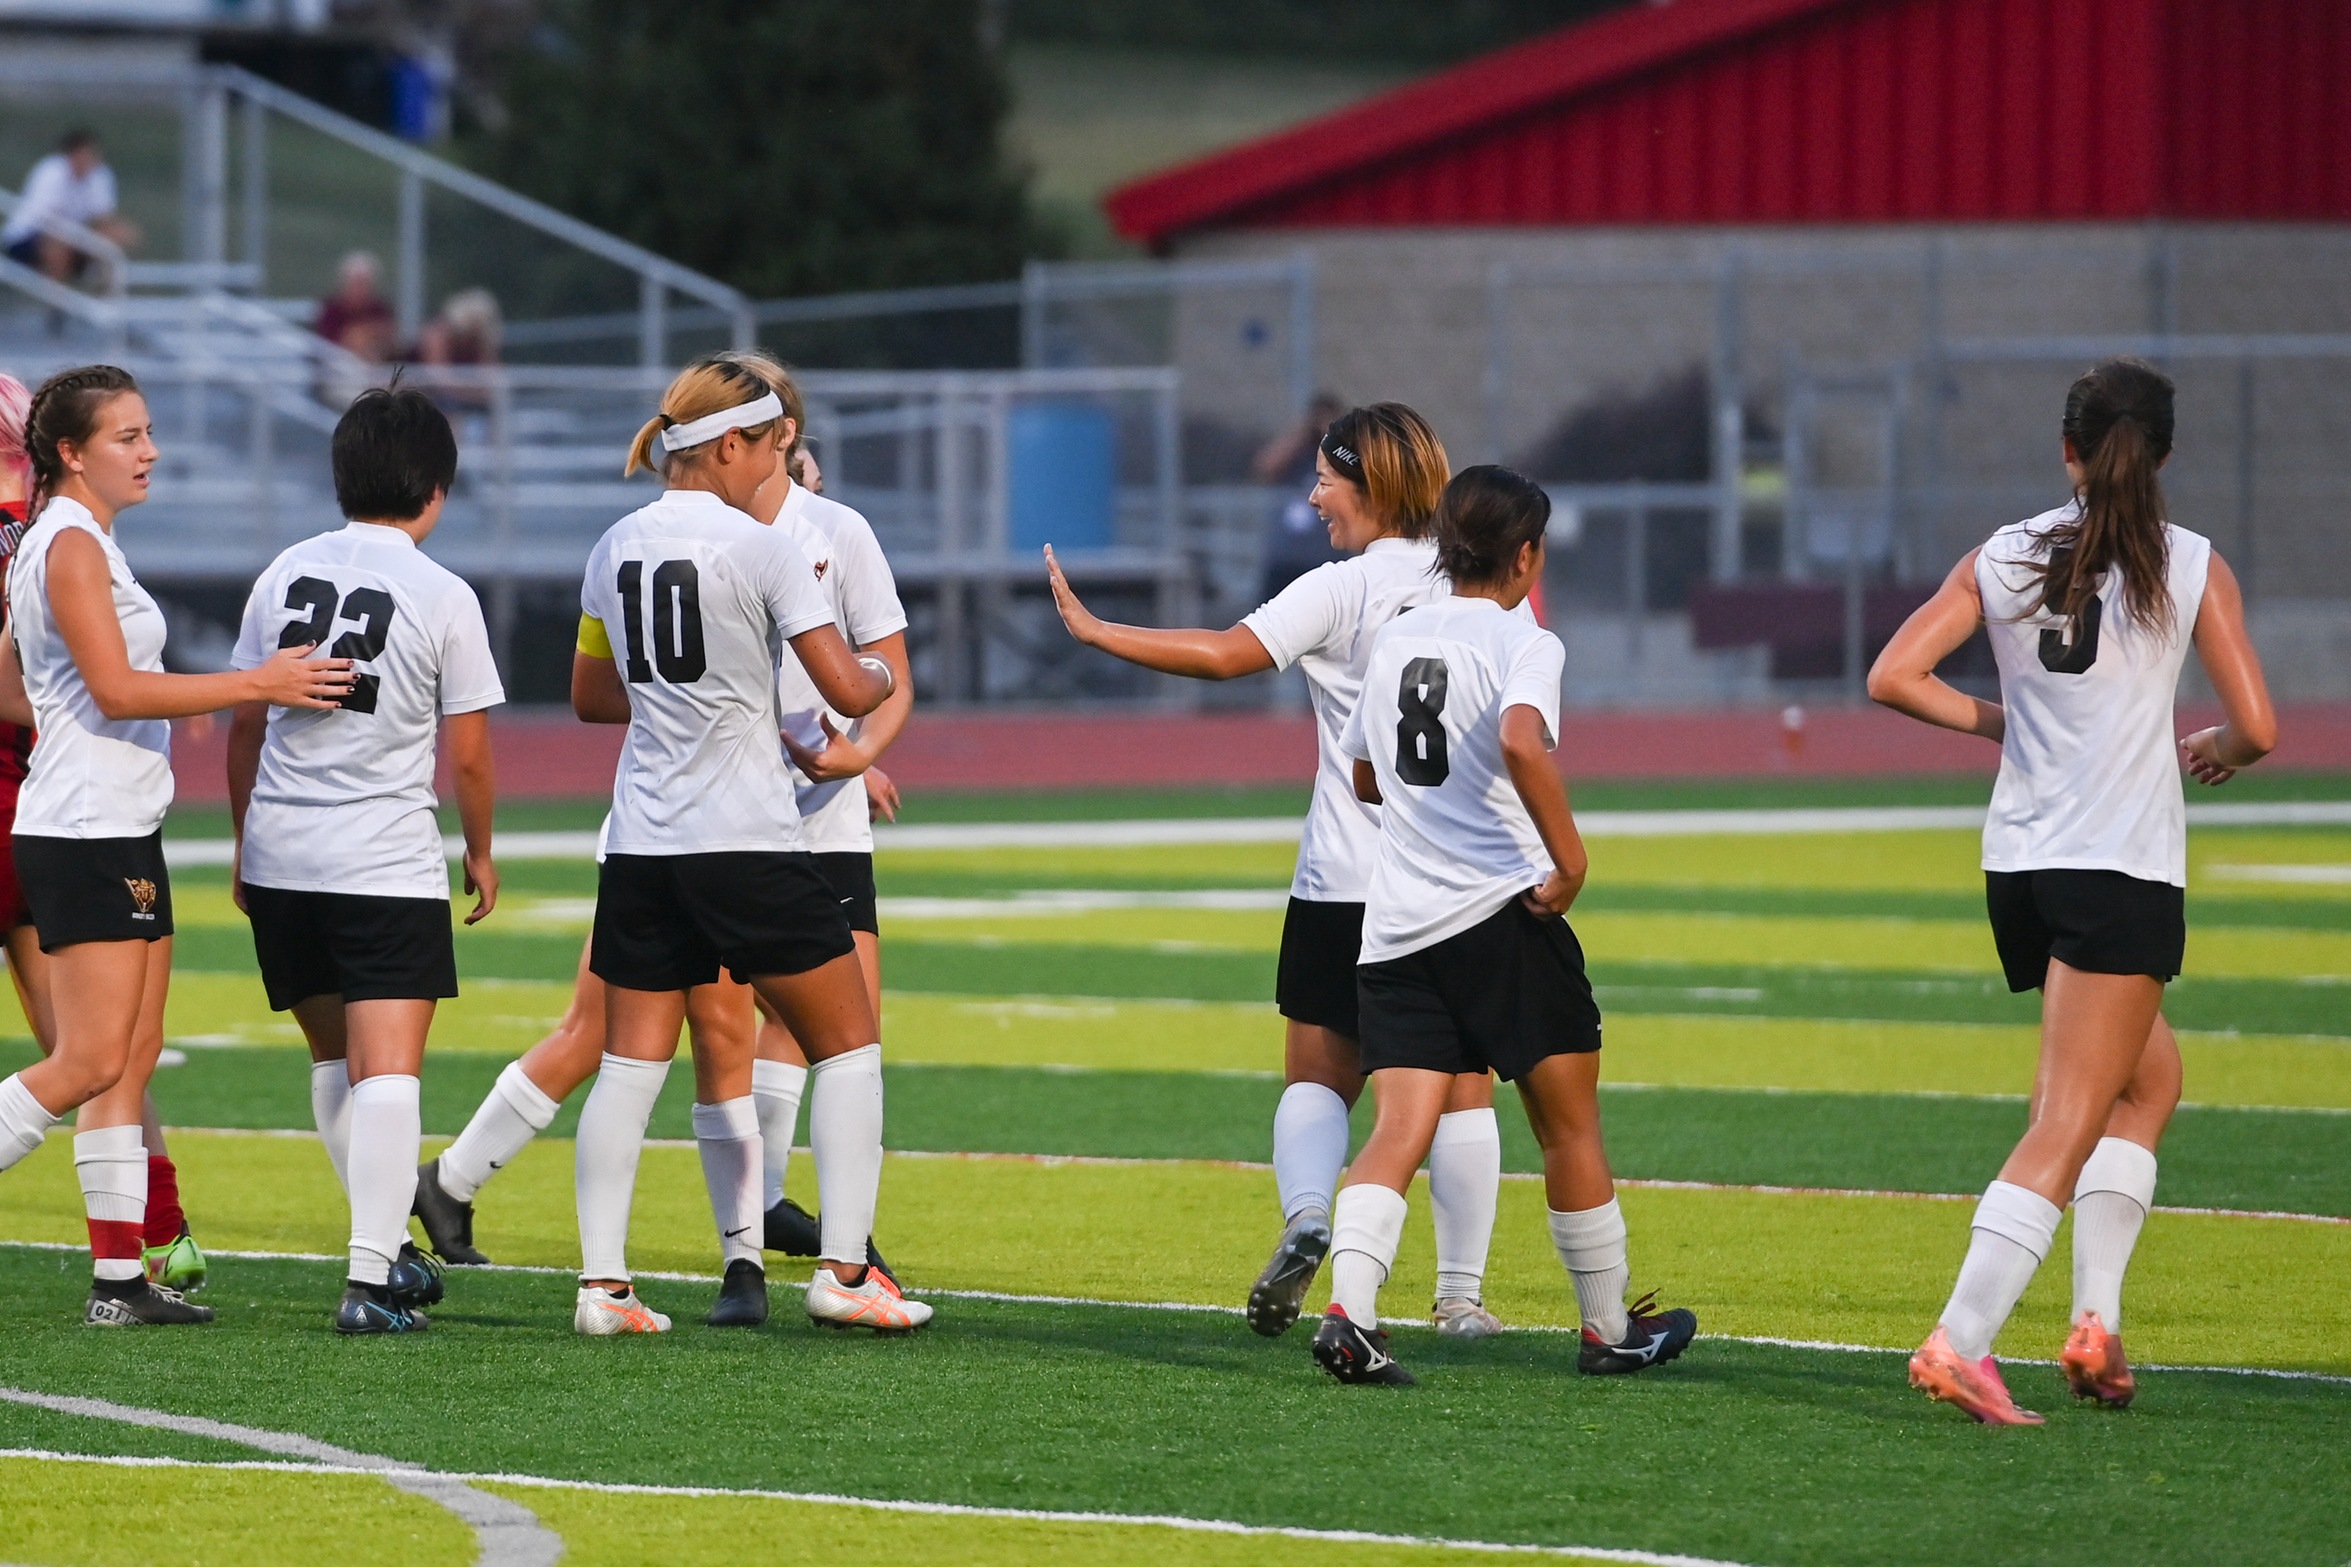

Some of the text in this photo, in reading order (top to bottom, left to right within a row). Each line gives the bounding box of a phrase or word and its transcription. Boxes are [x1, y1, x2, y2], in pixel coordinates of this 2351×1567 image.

[1332, 445, 1360, 466] NIKE
[278, 575, 396, 715] 22
[617, 559, 706, 683] 10
[1395, 657, 1449, 786] 8
